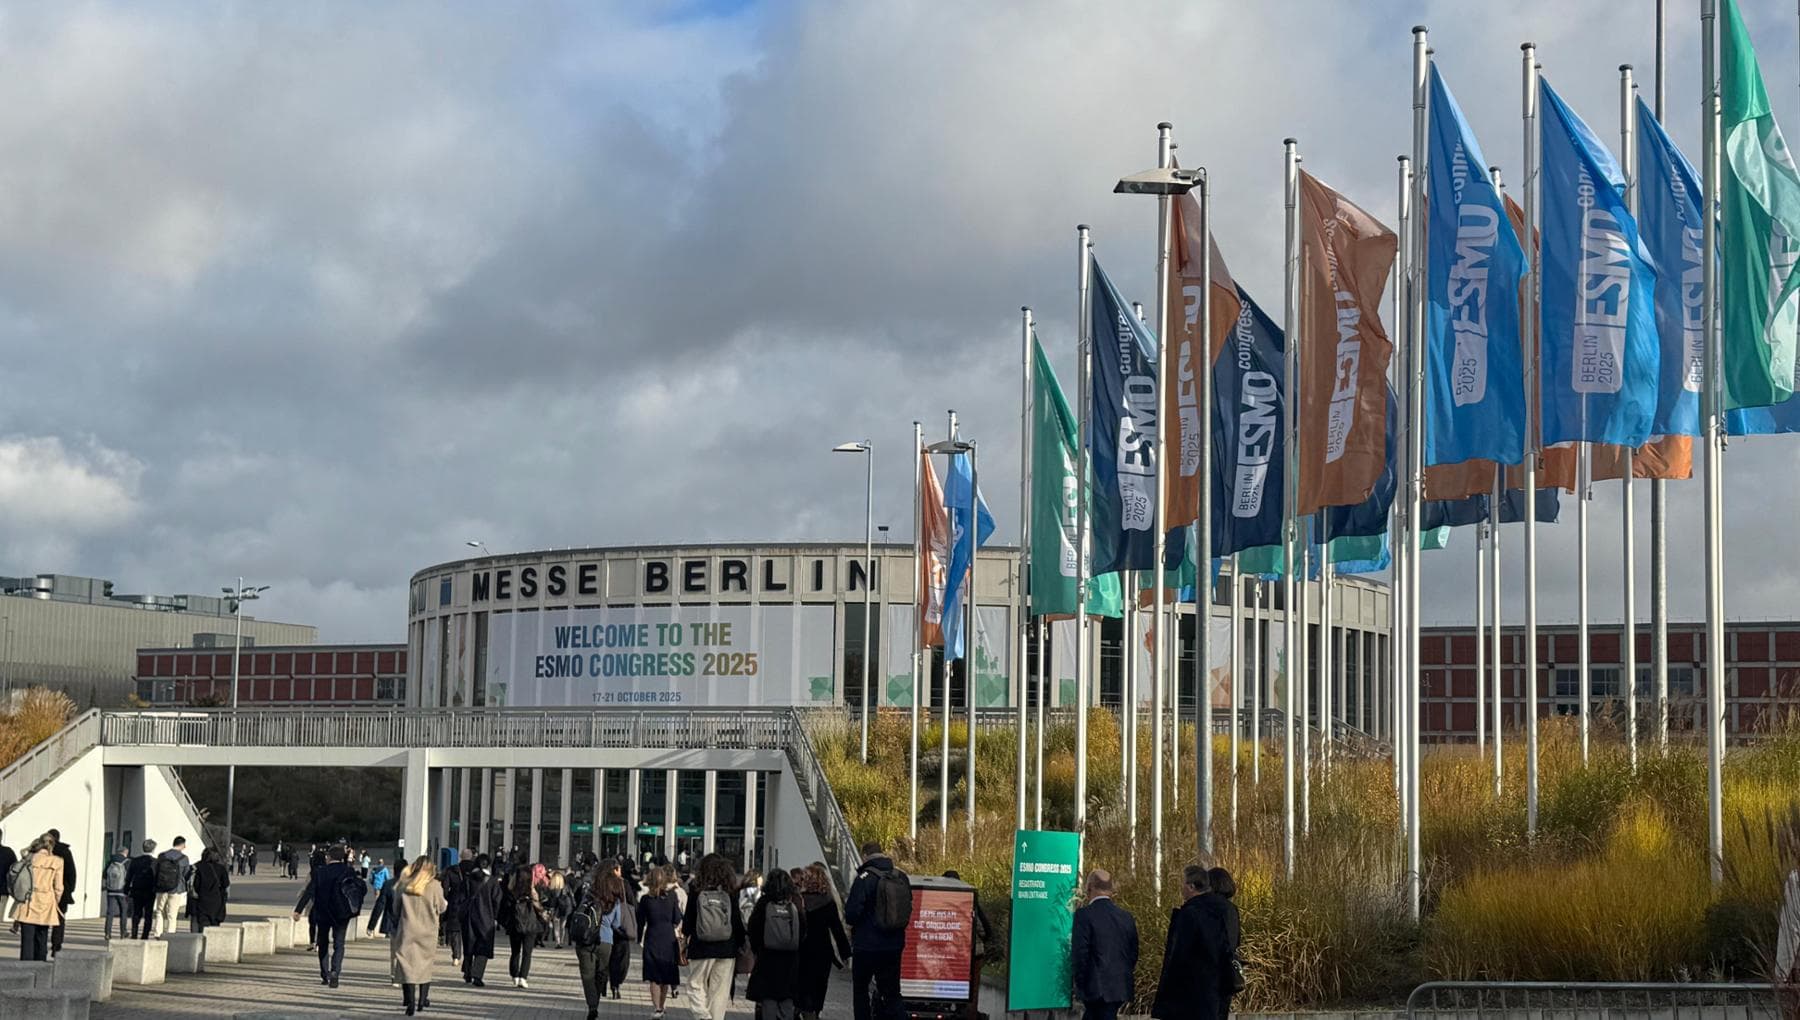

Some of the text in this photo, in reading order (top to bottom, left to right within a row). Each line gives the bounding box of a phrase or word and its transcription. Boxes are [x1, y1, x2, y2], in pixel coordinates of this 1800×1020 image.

[1575, 208, 1631, 326] ESMO
[1461, 358, 1477, 393] 2025
[1580, 335, 1598, 383] BERLIN
[1597, 352, 1614, 385] 2025
[1237, 299, 1277, 464] ESMO congress
[1117, 375, 1156, 475] ESMO
[1187, 432, 1200, 466] 2025
[1133, 496, 1147, 523] 2025
[1239, 473, 1254, 511] BERLIN
[472, 559, 876, 601] MESSE BERLIN
[555, 622, 732, 649] WELCOME TO THE
[535, 652, 758, 678] ESMO CONGRESS 2025
[592, 692, 681, 702] 17-21 OCTOBER 2025
